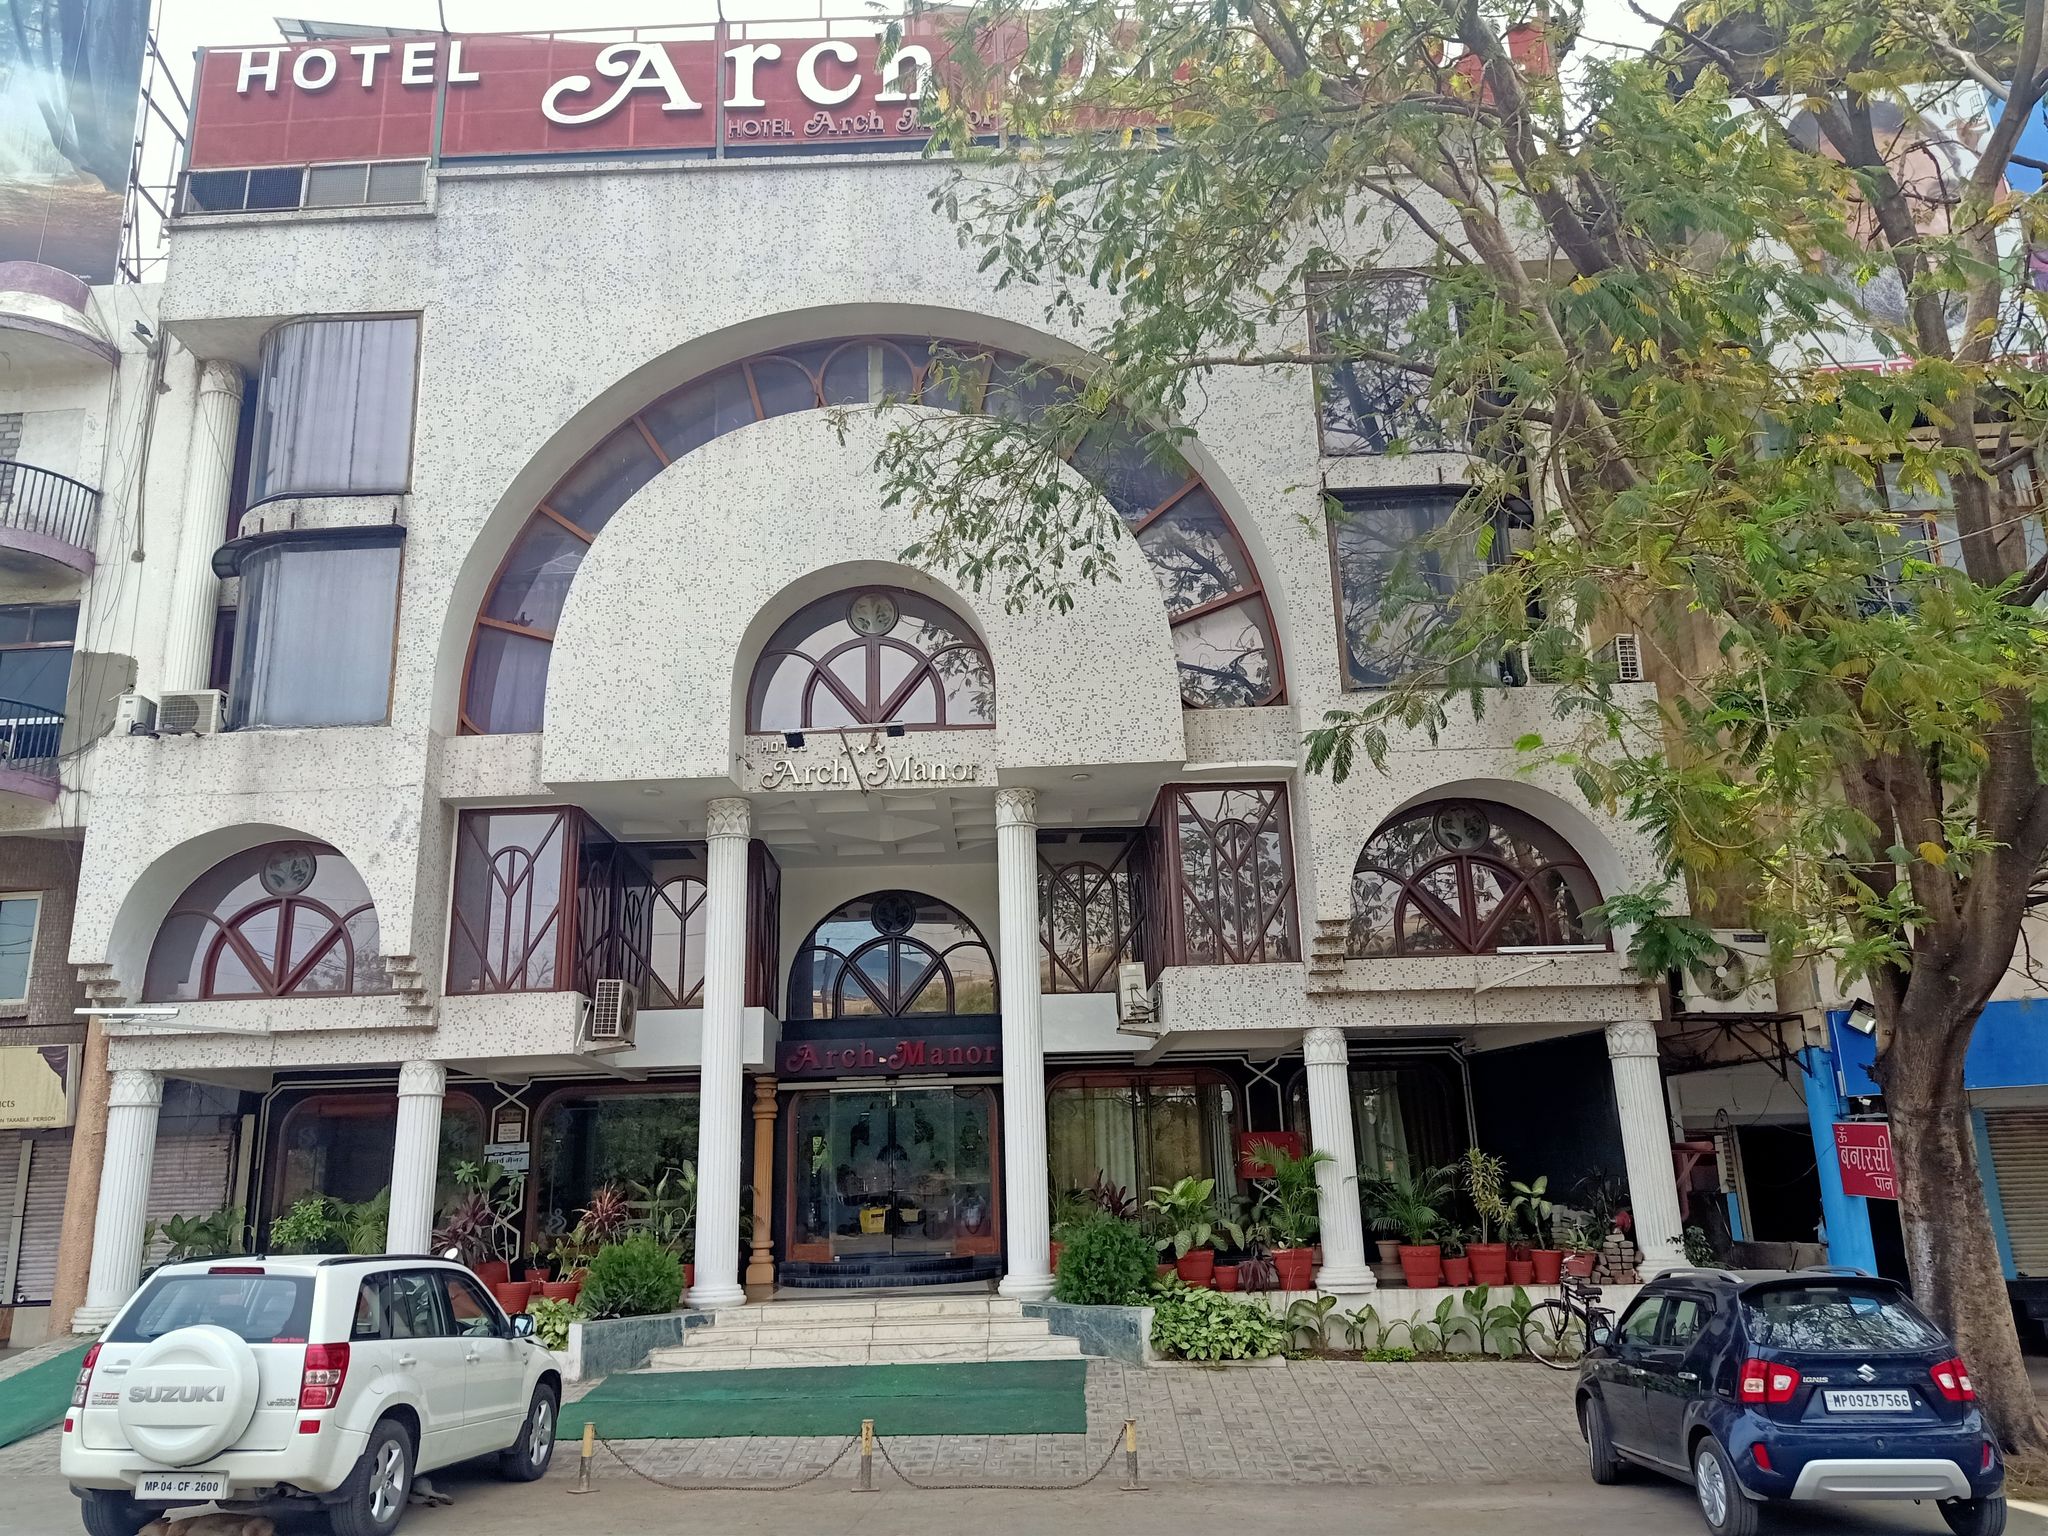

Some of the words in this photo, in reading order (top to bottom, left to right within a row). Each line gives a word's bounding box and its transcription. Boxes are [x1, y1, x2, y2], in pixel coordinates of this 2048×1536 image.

[236, 41, 480, 94] HOTEL
[541, 24, 938, 125] Arch
[728, 118, 794, 137] HOTEL
[803, 108, 885, 137] Arch
[761, 741, 807, 752] HOT
[760, 758, 850, 789] Arch
[865, 755, 979, 786] Manor
[785, 1040, 876, 1073] Arch
[888, 1039, 996, 1071] Manor
[1839, 1135, 1890, 1172] बनारसी
[1873, 1176, 1895, 1197] पान
[128, 1385, 225, 1403] SUZUKI
[1833, 1394, 1909, 1407] MP09ZB7566
[194, 1481, 219, 1491] 2600
